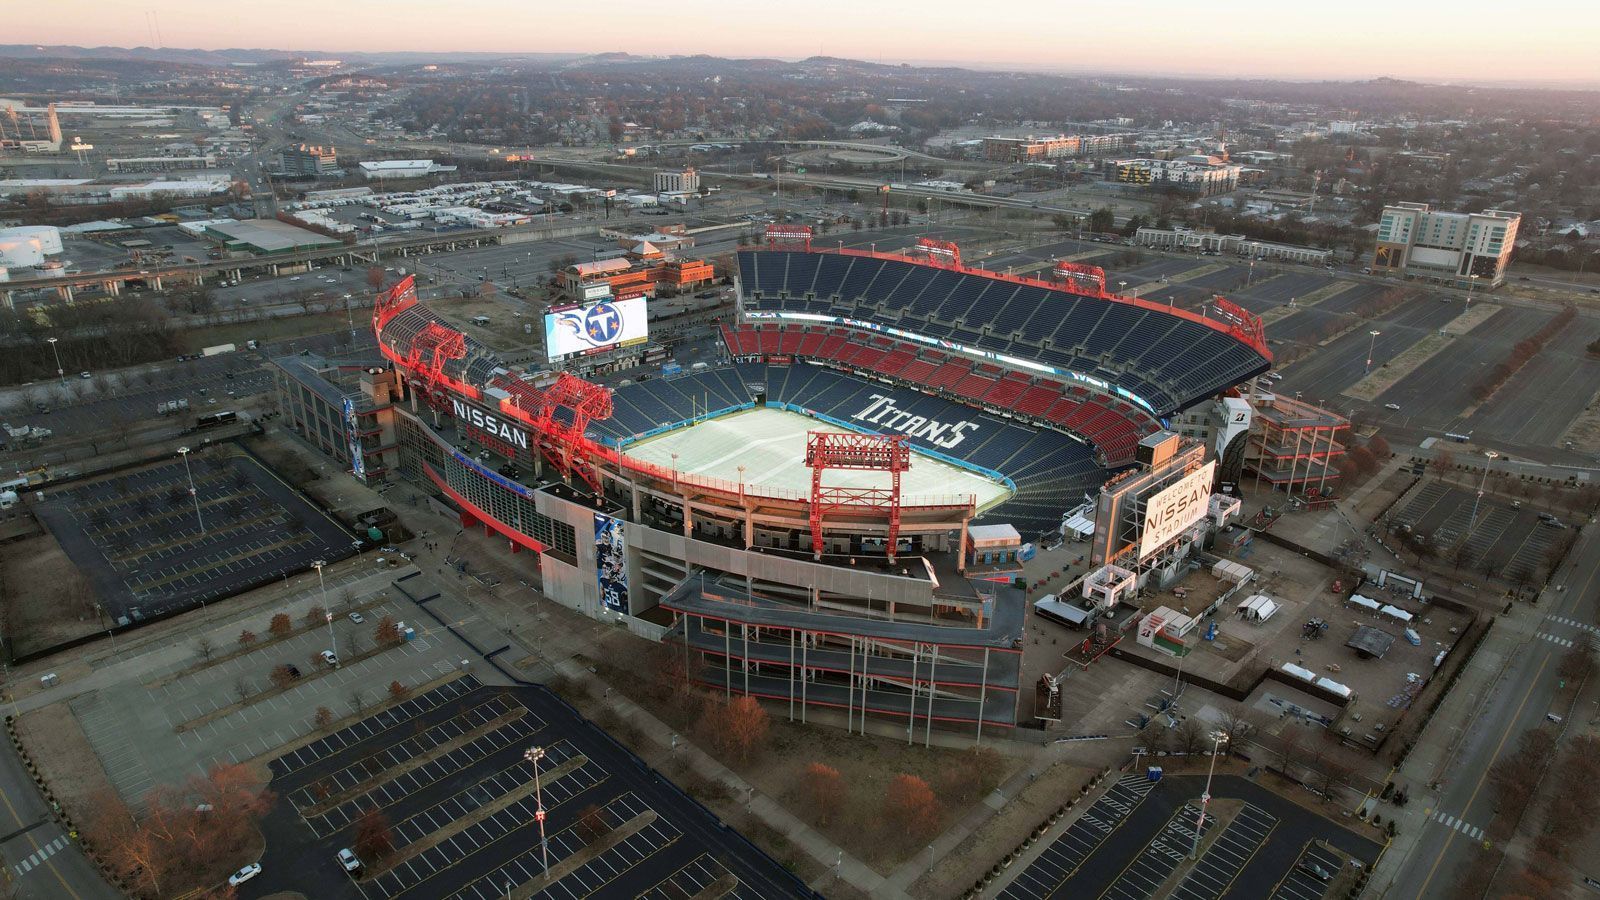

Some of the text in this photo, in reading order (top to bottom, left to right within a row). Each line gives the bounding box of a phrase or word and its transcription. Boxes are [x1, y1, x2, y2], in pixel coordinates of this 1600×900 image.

[618, 292, 640, 300] NISSAN
[453, 399, 527, 449] NISSAN
[1145, 481, 1212, 534] NISSAN
[1156, 470, 1208, 508] WELCOME TO
[1154, 507, 1198, 543] STADIUM
